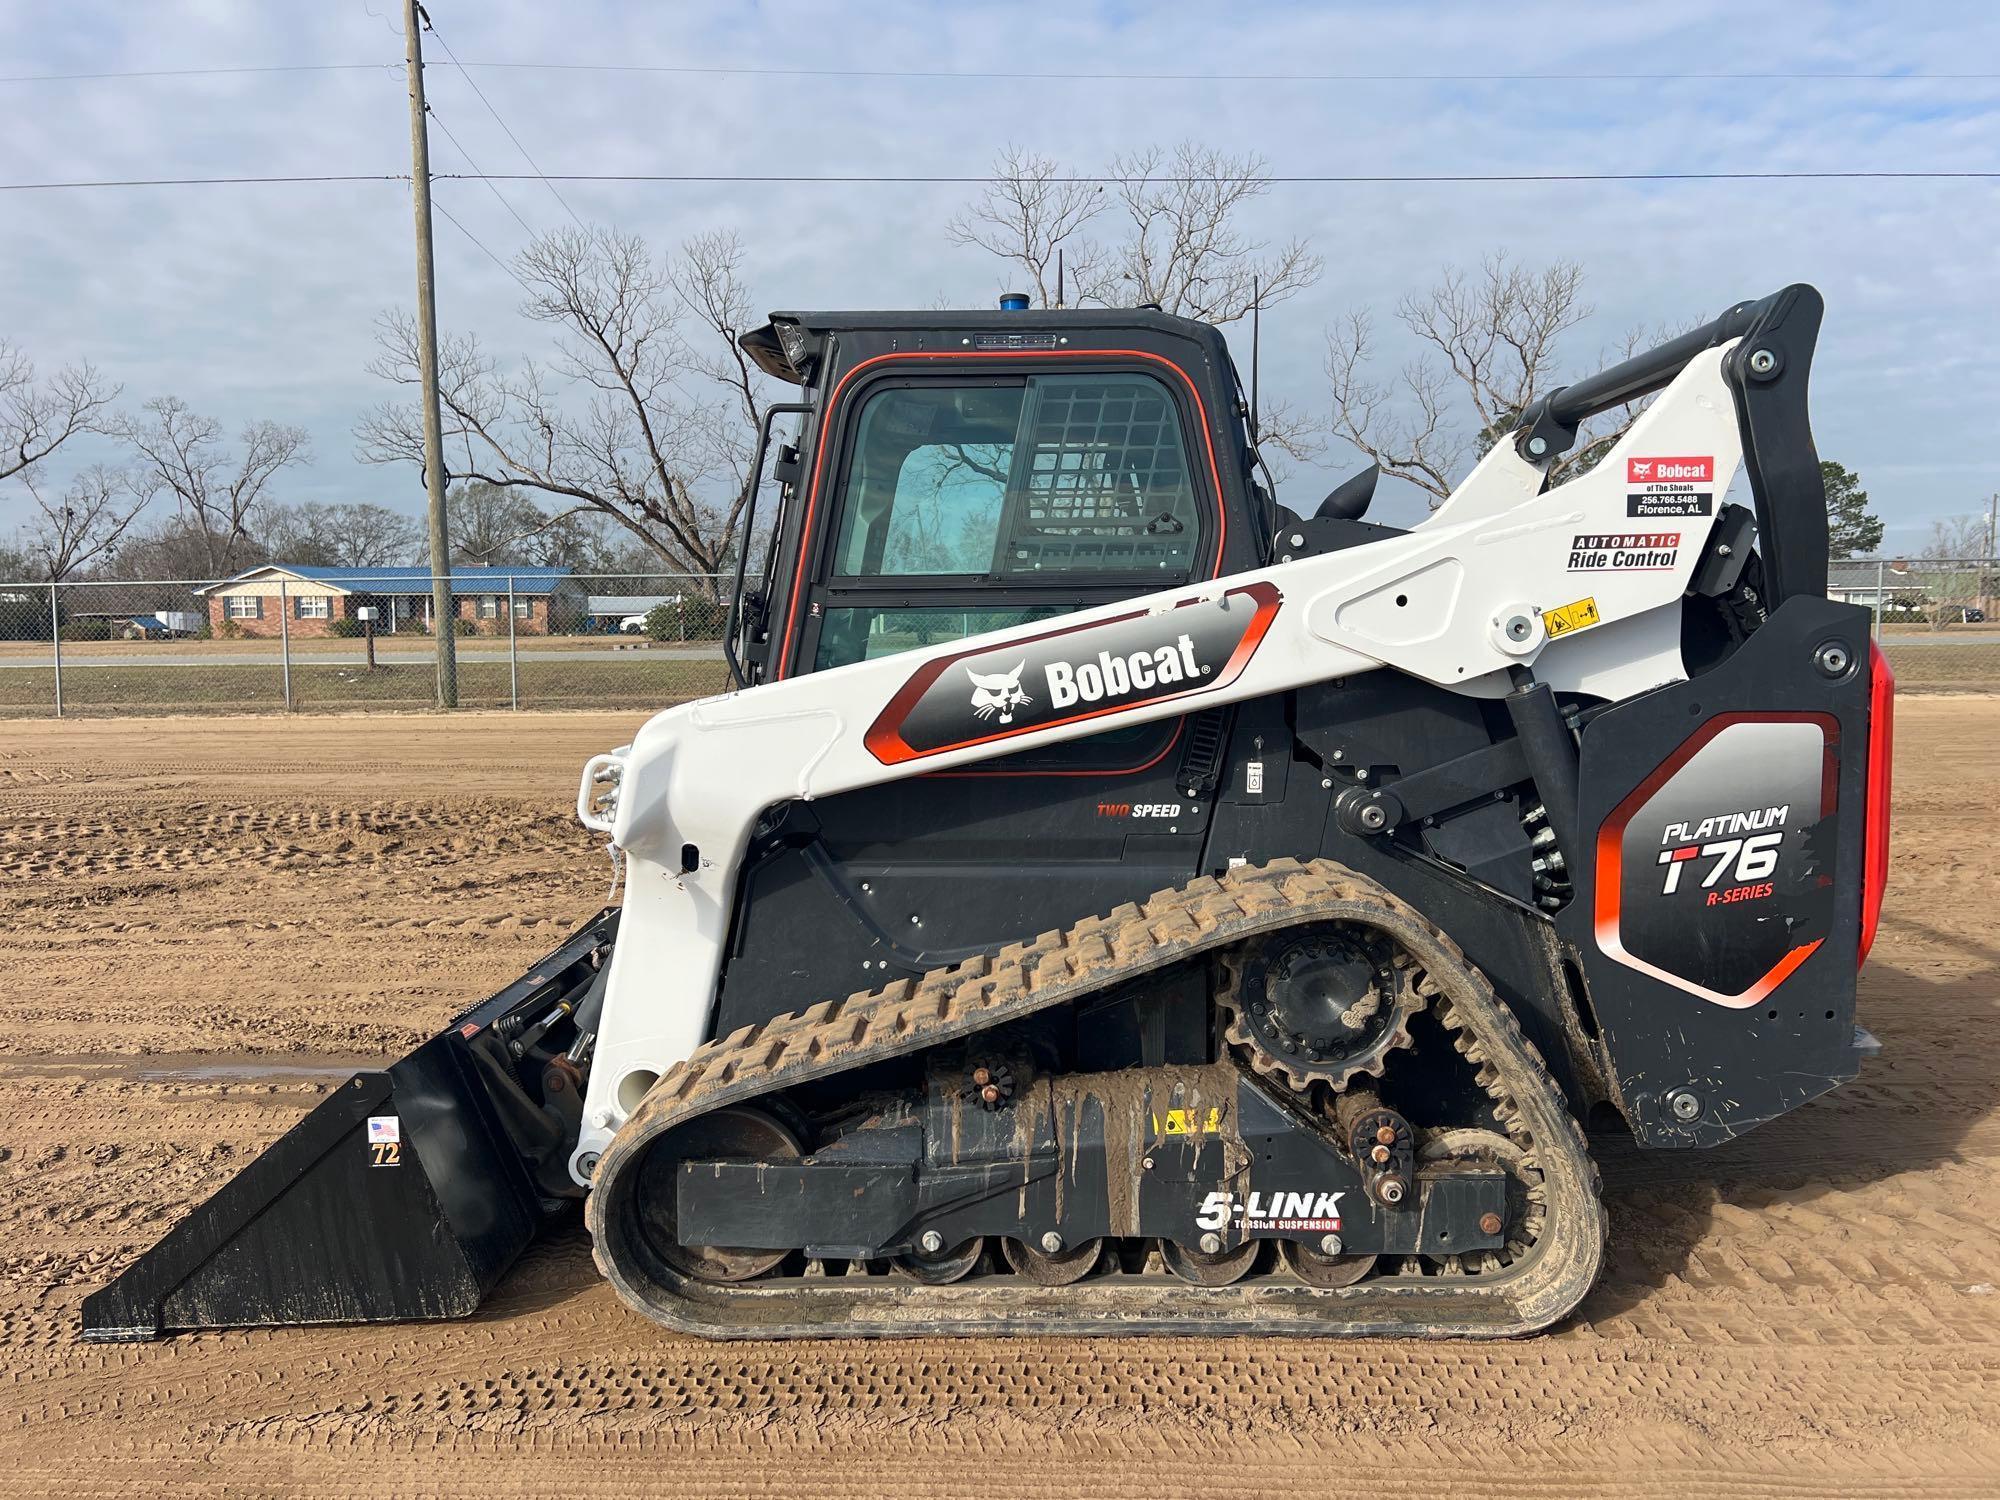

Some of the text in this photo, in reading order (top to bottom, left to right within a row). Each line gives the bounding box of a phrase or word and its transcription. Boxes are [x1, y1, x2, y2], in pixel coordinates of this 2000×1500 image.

[1657, 464, 1705, 478] Bobcat
[1655, 484, 1668, 492] The
[1669, 484, 1694, 492] Shoals
[1641, 495, 1698, 504] 256.766.5488
[1637, 504, 1702, 515] Florence, AL
[1576, 535, 1676, 548] AUTOMATIC
[1567, 549, 1677, 568] Ride Control
[1098, 804, 1181, 818] TWO SPEED
[1661, 804, 1790, 845] PLATINUM
[1657, 831, 1783, 895] T76
[1706, 882, 1774, 907] R-SERIES
[1195, 1191, 1346, 1231] 5-LINK
[1278, 1219, 1338, 1231] SUSPENSION
